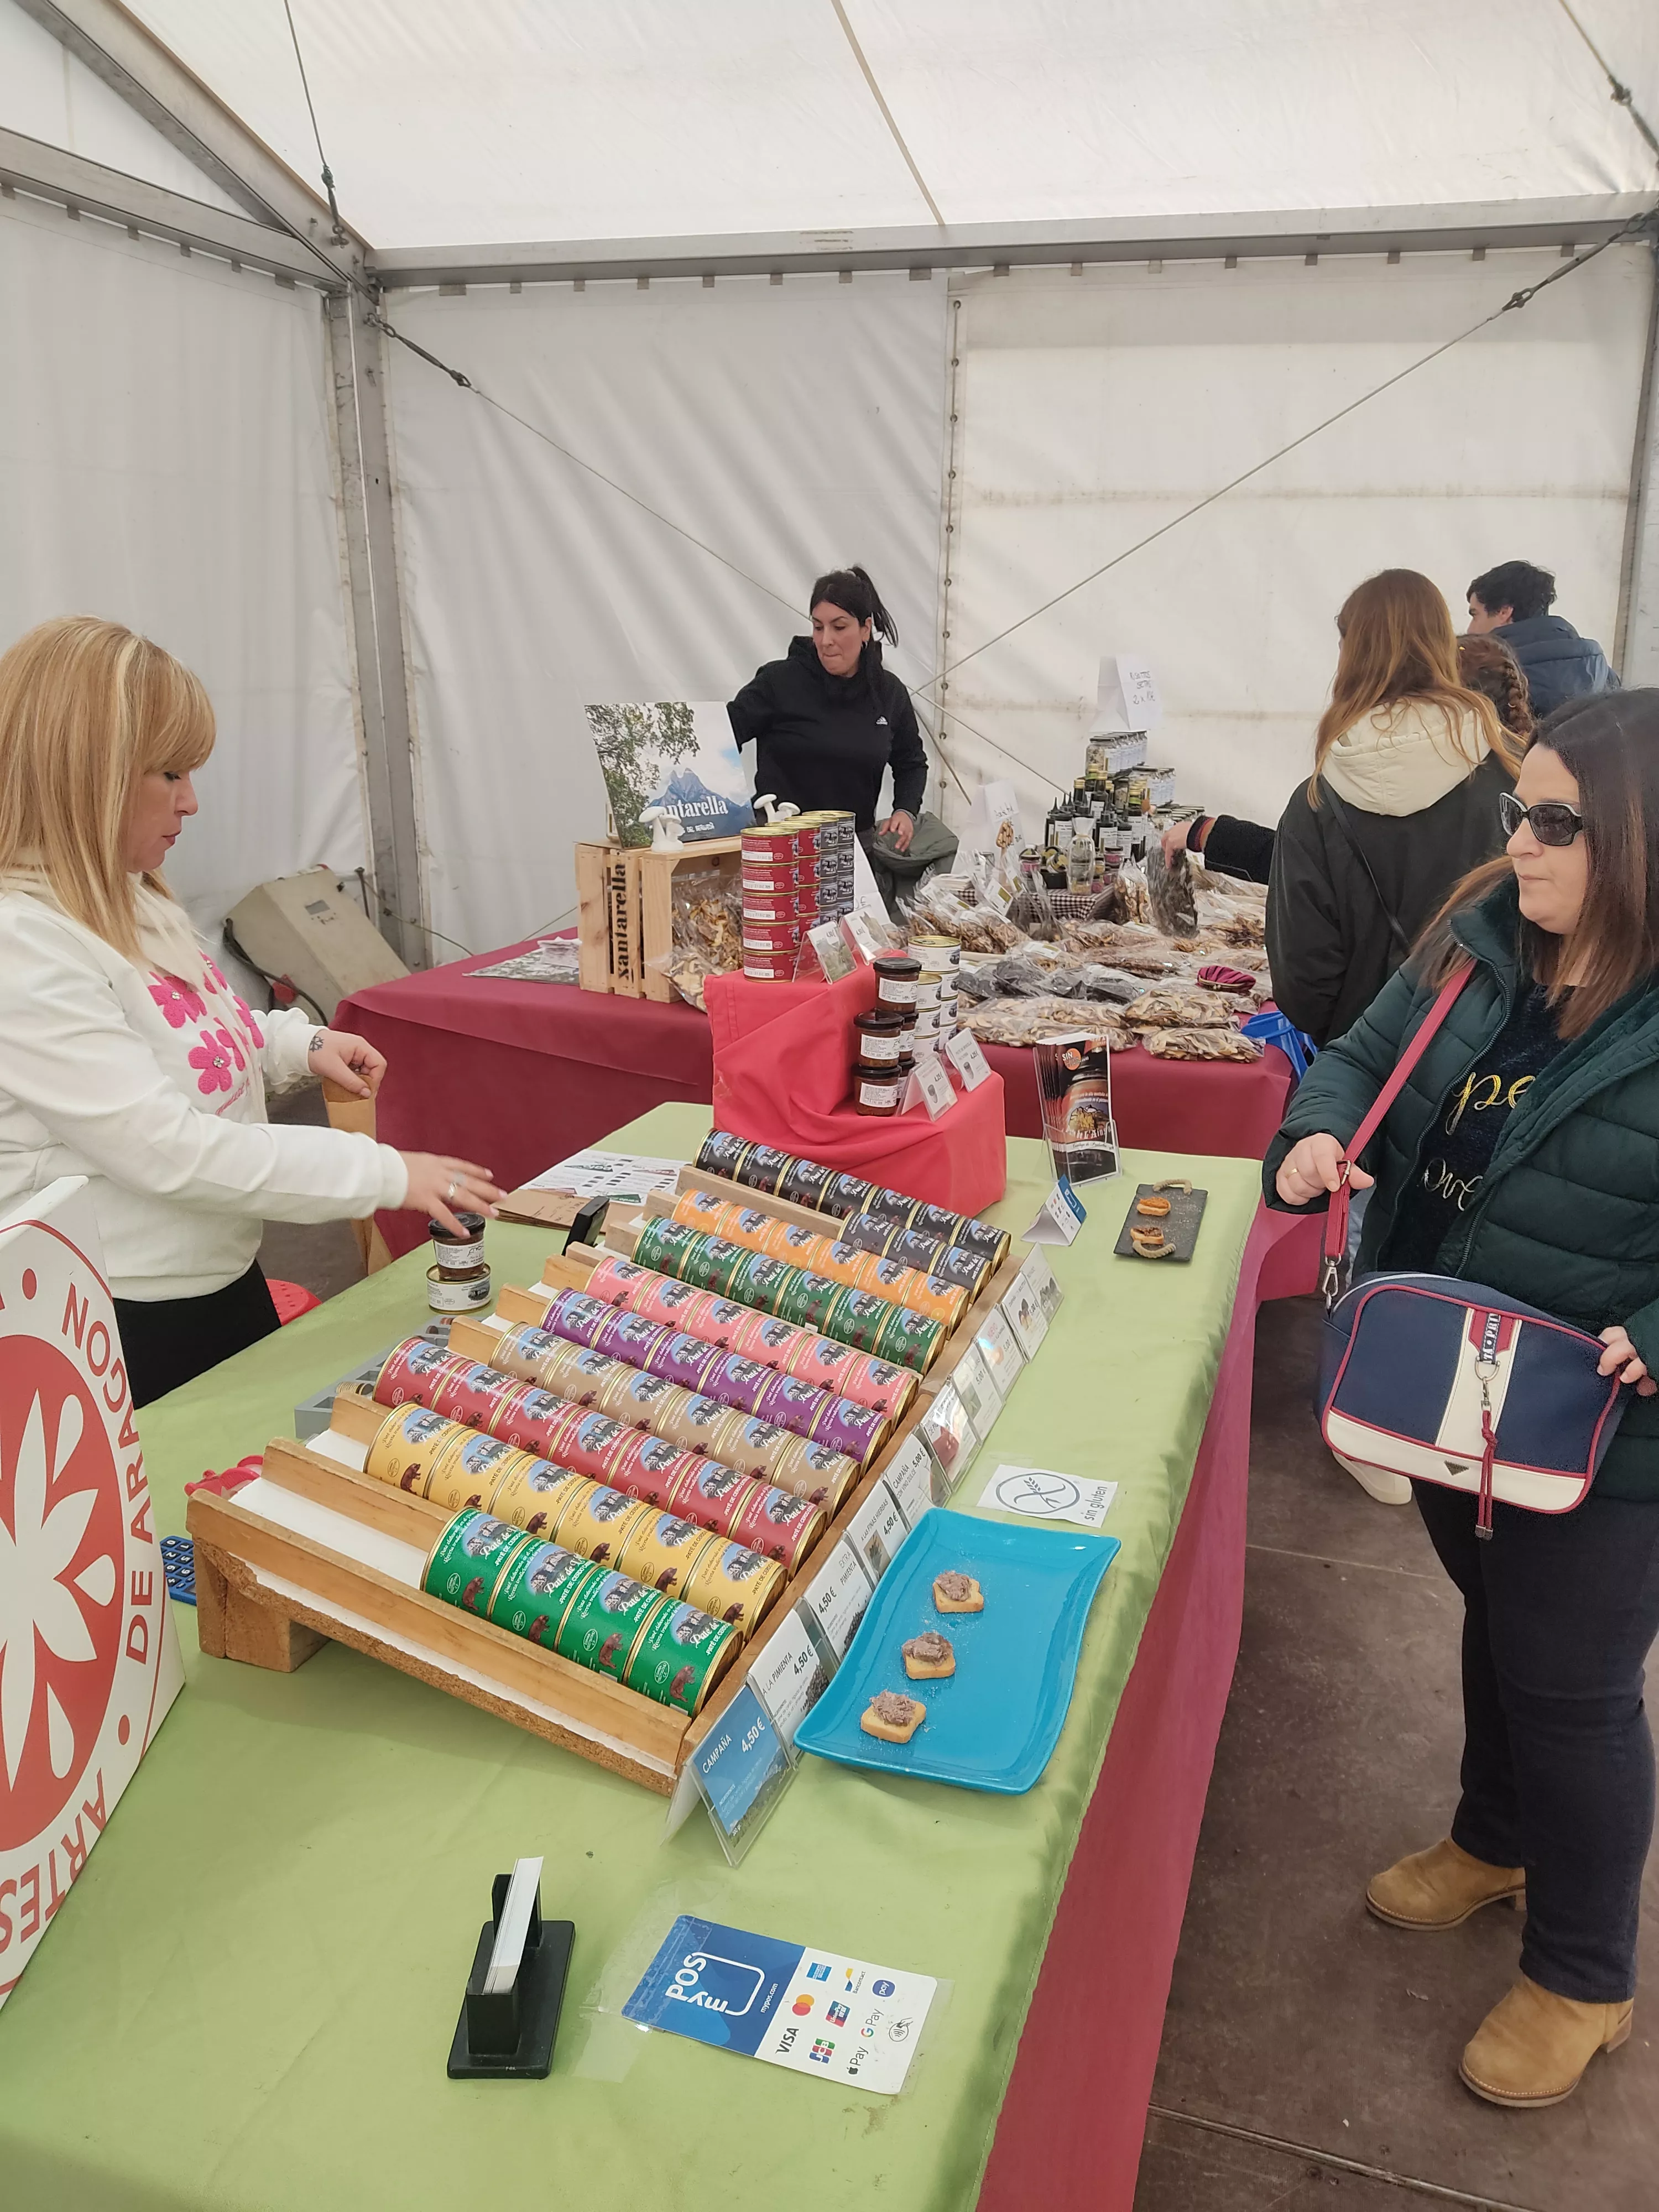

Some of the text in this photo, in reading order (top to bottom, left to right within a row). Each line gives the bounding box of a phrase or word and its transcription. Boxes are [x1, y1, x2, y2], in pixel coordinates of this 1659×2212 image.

[1062, 1051, 1073, 1061] SIN
[593, 1436, 614, 1454] Paté
[608, 1447, 614, 1456] DE
[656, 1455, 676, 1474] Paté
[671, 1466, 677, 1475] DE
[893, 1464, 910, 1489] CAMPAÑA
[714, 1482, 735, 1501] Paté
[730, 1494, 737, 1502] DE
[1081, 1486, 1108, 1521] sin gluten
[782, 1506, 802, 1526] Paté
[797, 1518, 804, 1526] DE
[867, 1516, 877, 1532] FINAS
[875, 1499, 889, 1519] HIERBAS
[480, 1539, 502, 1560] Paté
[839, 1551, 852, 1568] EXTRA
[840, 1561, 857, 1585] PIMIENTA
[544, 1574, 566, 1597] Paté
[567, 1580, 575, 1589] DE
[618, 1596, 640, 1616] Paté
[641, 1601, 648, 1610] DE
[126, 1571, 153, 1665] DE
[691, 1629, 713, 1648] Paté
[713, 1632, 721, 1642] DE
[766, 1680, 774, 1691] LA
[772, 1652, 793, 1682] PIMIENTA
[702, 1734, 732, 1773] CAMPAÑA
[665, 1952, 707, 2002] POS
[853, 1971, 866, 1994] Bancontact
[760, 1982, 779, 2014] mypos.com
[865, 2008, 884, 2026] Pay
[775, 2027, 800, 2054] VISA
[816, 2041, 830, 2062] JCB
[849, 2046, 869, 2067] Pay
